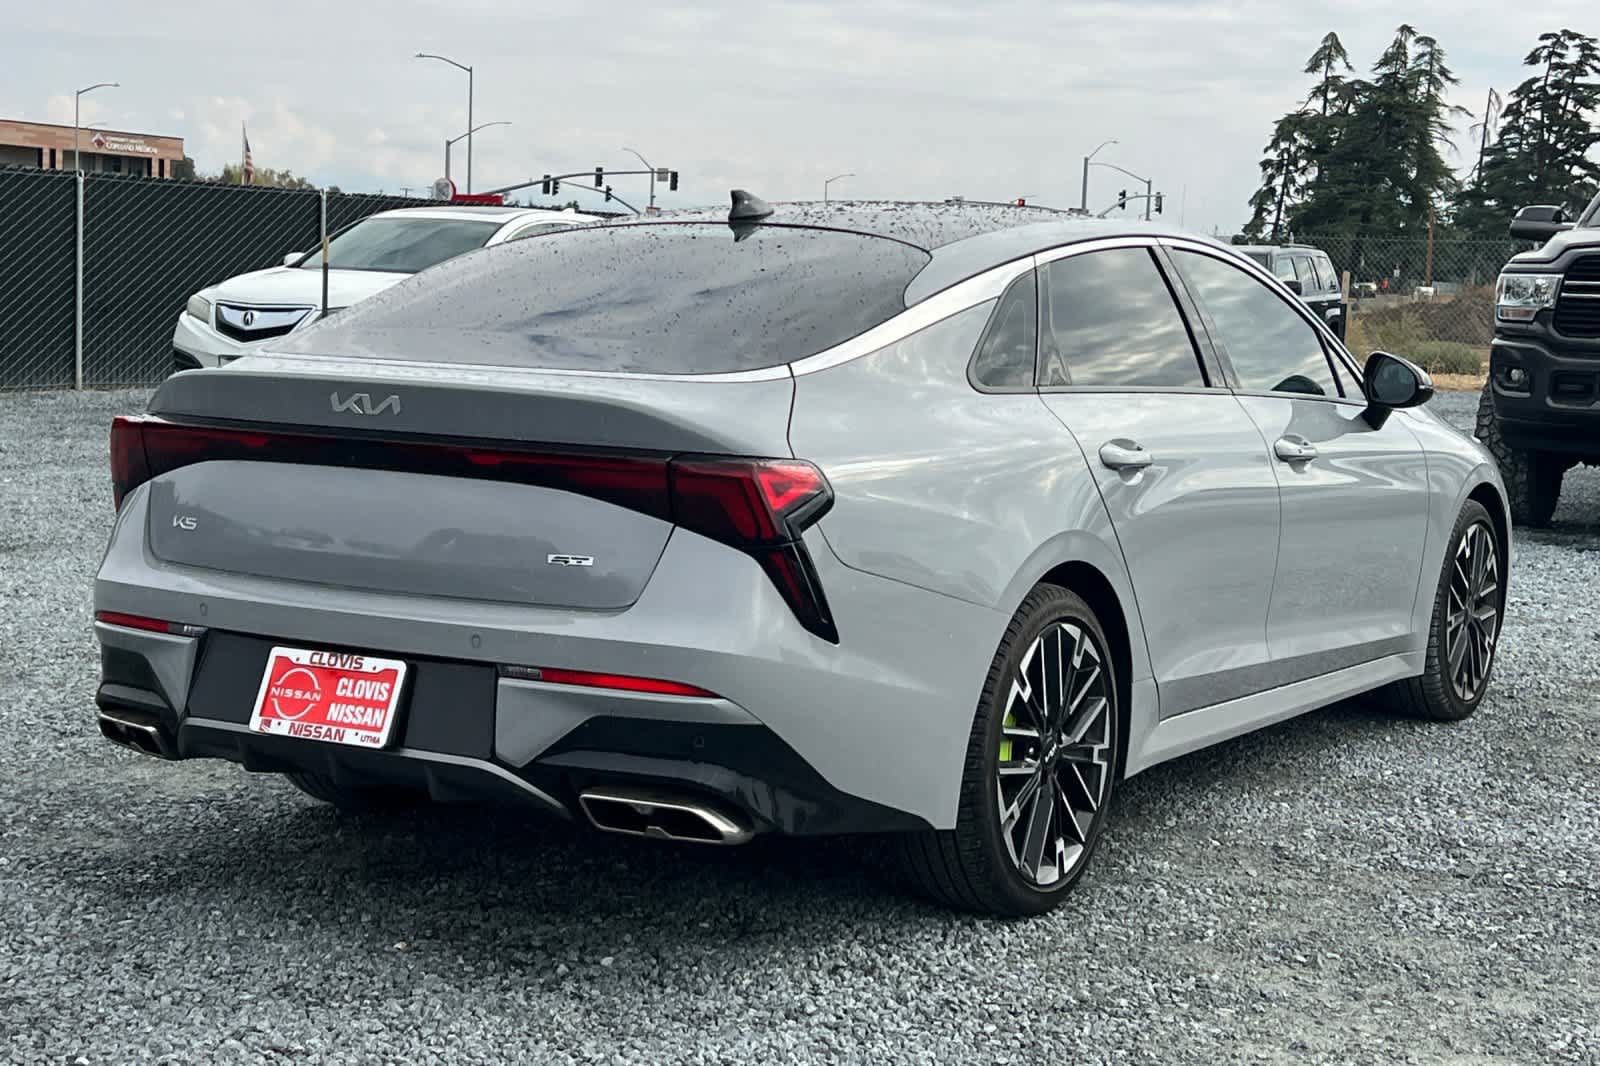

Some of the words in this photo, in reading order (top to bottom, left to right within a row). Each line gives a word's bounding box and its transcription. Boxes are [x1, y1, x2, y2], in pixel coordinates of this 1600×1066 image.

[330, 391, 401, 415] KIA
[172, 515, 198, 530] K5
[309, 652, 365, 670] CLOVIS
[270, 687, 322, 702] NISSAN
[335, 677, 391, 701] CLOVIS
[325, 702, 386, 728] NISSAN
[287, 722, 347, 742] NISSAN
